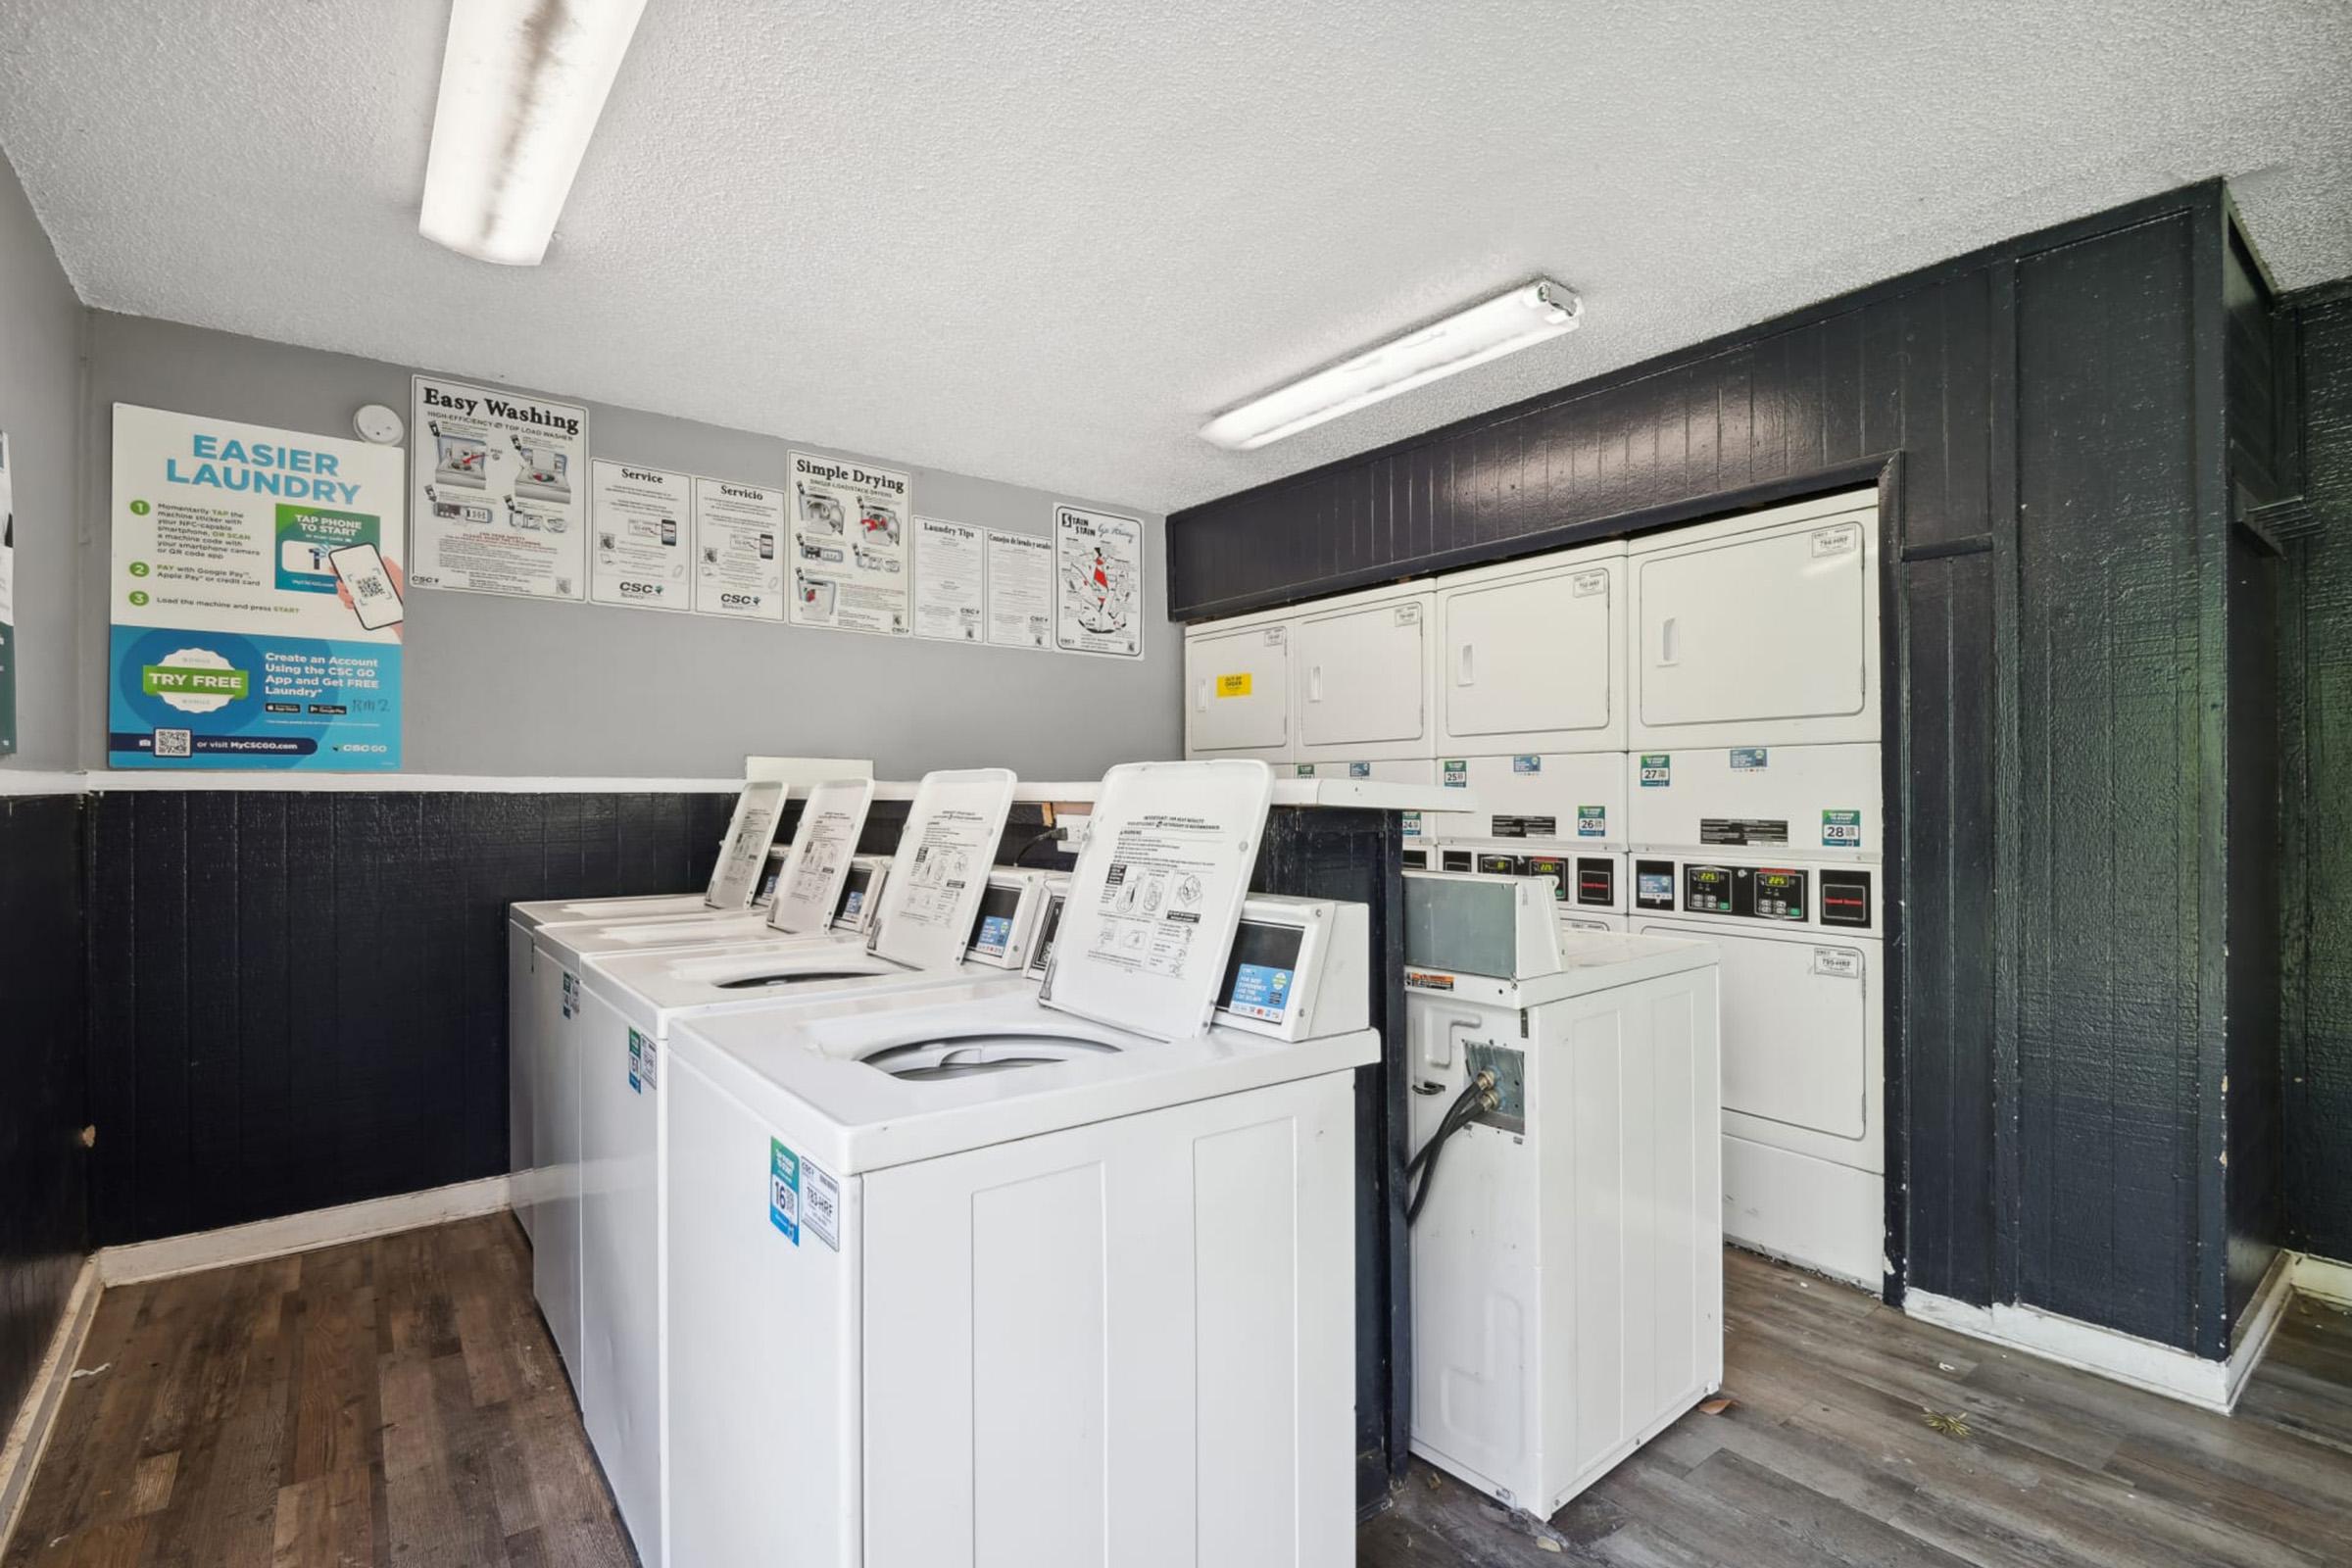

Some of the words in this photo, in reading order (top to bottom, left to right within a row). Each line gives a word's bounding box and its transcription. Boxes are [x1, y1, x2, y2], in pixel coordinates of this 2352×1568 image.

[423, 387, 478, 416] Easy
[484, 398, 579, 435] Washing
[193, 434, 339, 477] EASIER
[621, 467, 663, 484] Service
[797, 459, 849, 481] Simple
[853, 469, 904, 494] Drying
[167, 459, 361, 505] LAUNDRY
[721, 485, 763, 501] Servicio
[137, 502, 144, 513] 1
[158, 503, 209, 515] Momentarily
[158, 511, 193, 520] machine
[196, 515, 222, 524] sticker
[295, 514, 319, 524] TAP
[320, 517, 363, 530] PHONE
[179, 519, 232, 531] NFC-capable
[300, 522, 317, 532] TO
[319, 525, 358, 537] START
[924, 522, 956, 537] Laundry
[957, 527, 974, 539] Tips
[165, 533, 200, 543] machine
[227, 532, 251, 541] SCAN
[179, 542, 227, 553] smartphone
[134, 564, 144, 575] 2
[197, 567, 227, 576] Google
[619, 581, 654, 594] CSC
[134, 593, 144, 604] 3
[196, 600, 230, 609] machine
[720, 593, 752, 605] CSC
[266, 652, 307, 663] Create
[329, 657, 378, 667] Account
[266, 663, 301, 675] Using
[305, 665, 324, 675] the
[328, 666, 353, 676] CSC
[357, 668, 375, 677] GO
[149, 672, 187, 686] TRY
[193, 675, 242, 689] FREE
[266, 674, 292, 685] App
[296, 677, 318, 686] and
[322, 677, 343, 687] Get
[347, 679, 379, 689] FREE
[230, 741, 298, 750] MyCSCGO.com
[343, 744, 370, 753] CSC
[1446, 772, 1457, 782] 25
[1644, 769, 1657, 779] 27
[1581, 819, 1593, 829] 26
[1827, 826, 1844, 838] 28
[774, 1181, 786, 1210] 16
